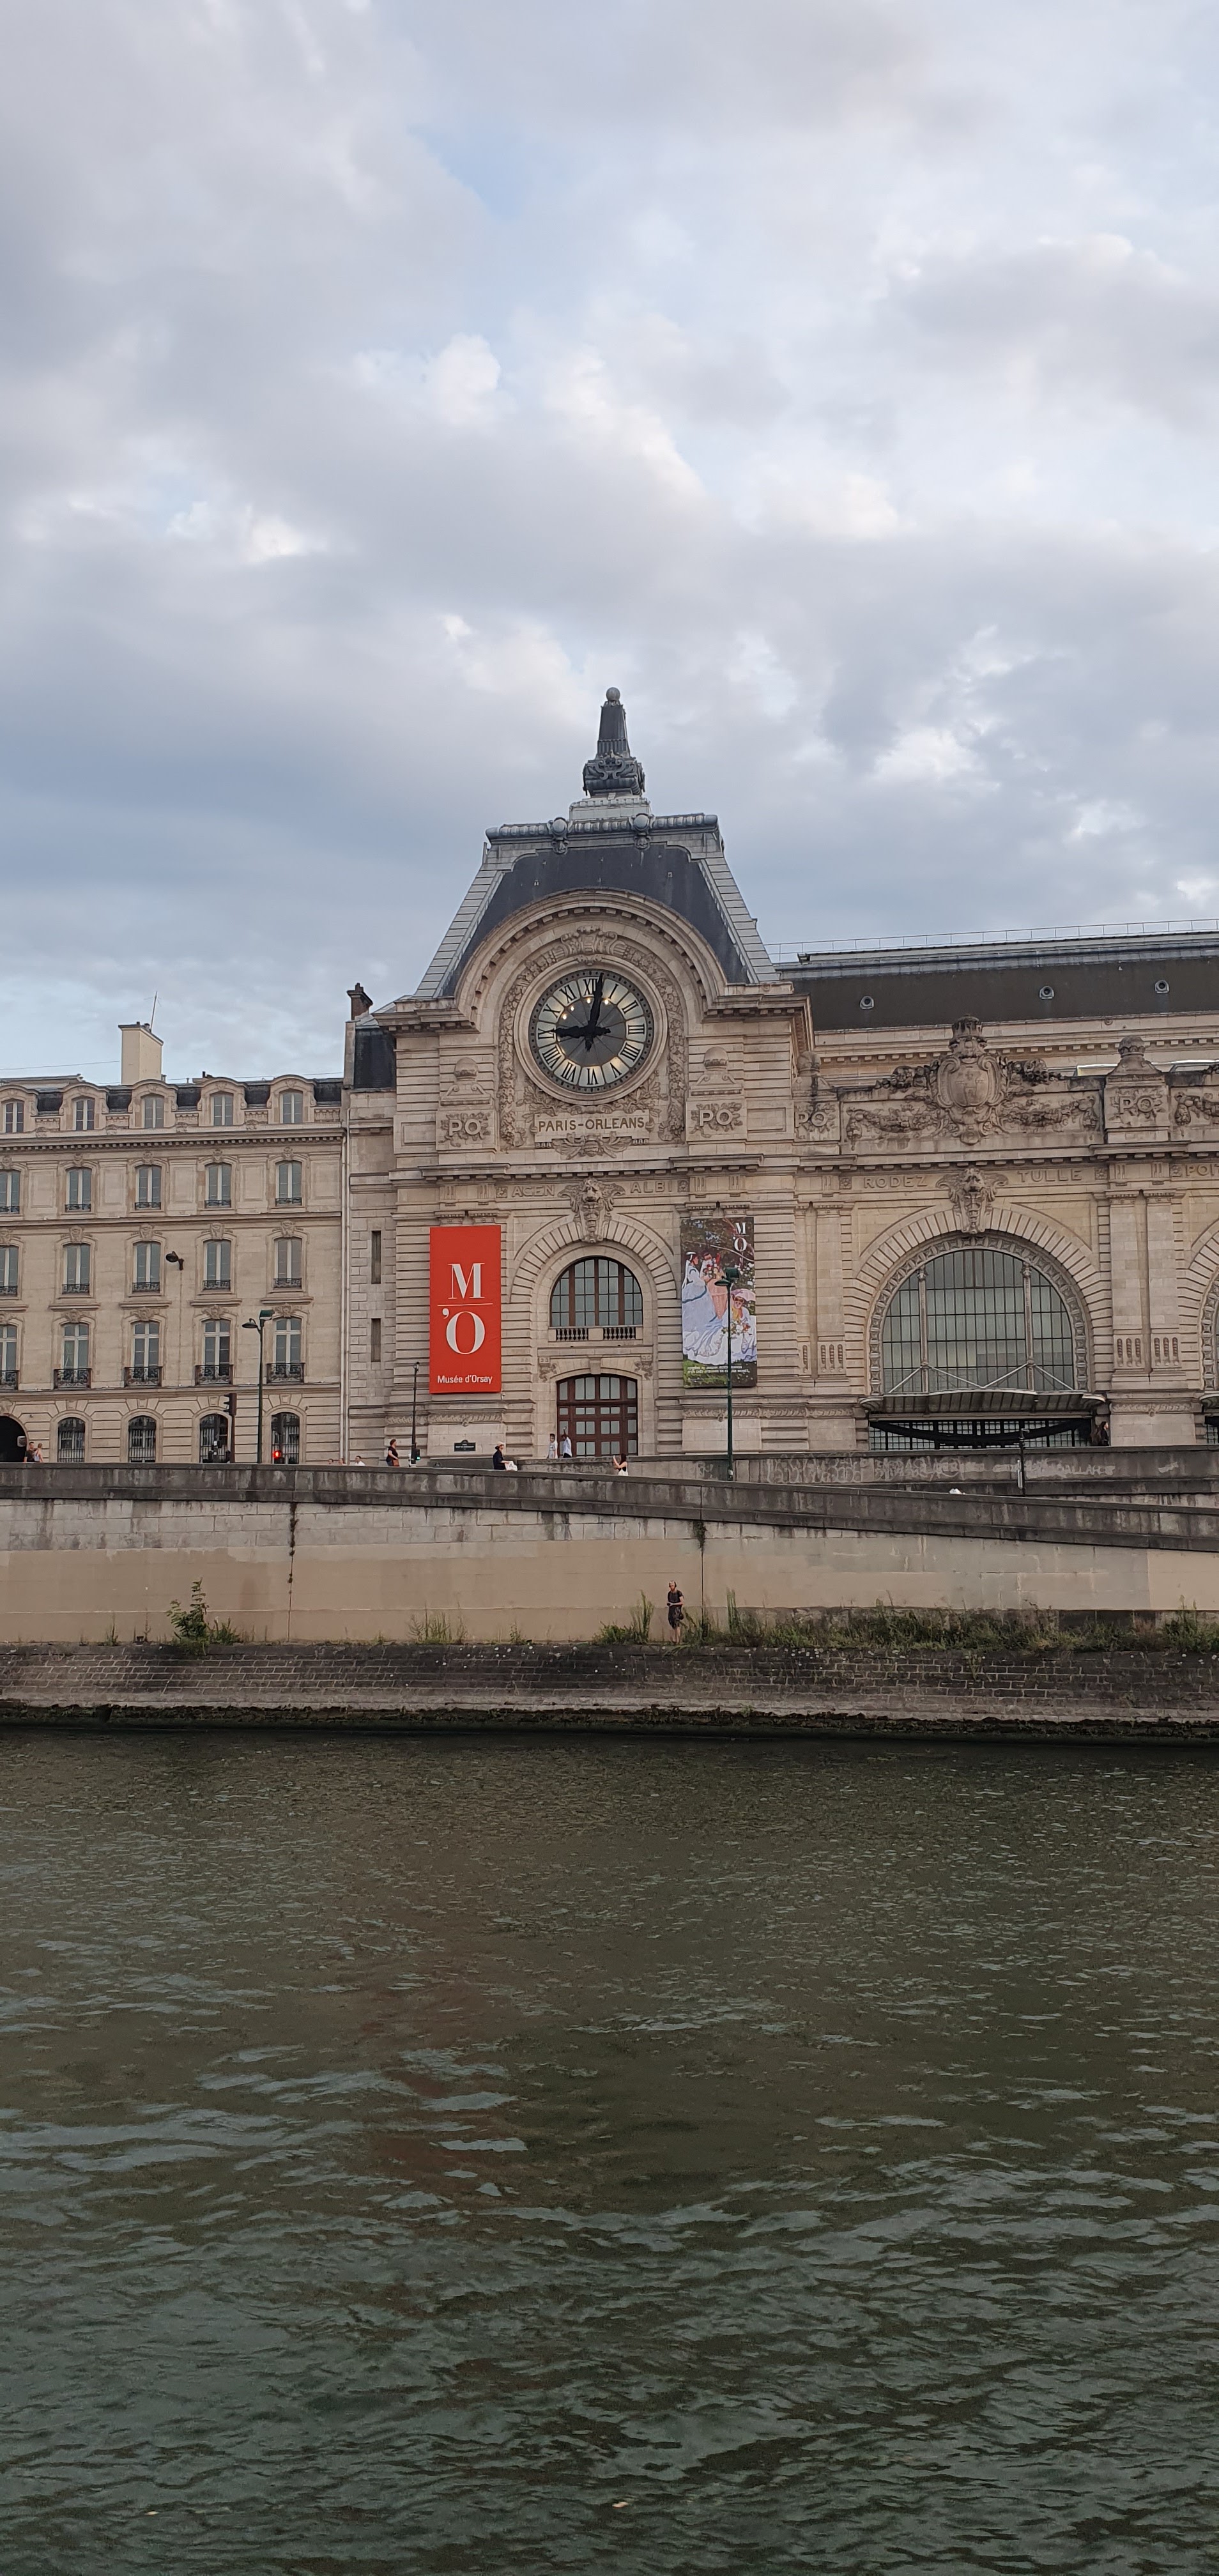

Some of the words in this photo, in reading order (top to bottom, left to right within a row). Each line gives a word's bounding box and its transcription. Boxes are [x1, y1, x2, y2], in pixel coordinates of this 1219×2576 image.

[559, 984, 577, 1004] XI
[608, 984, 619, 999] I
[543, 1004, 561, 1018] X
[622, 1000, 639, 1015] II
[537, 1027, 555, 1040] IX
[627, 1023, 645, 1035] III
[542, 1045, 562, 1069] VIII
[620, 1042, 641, 1062] IIII
[560, 1061, 576, 1083] VII
[586, 1068, 599, 1085] VI
[610, 1062, 622, 1078] V
[1120, 1096, 1153, 1114] PO
[539, 1117, 645, 1132] PARIS-ORLEANS
[699, 1109, 733, 1126] PO
[794, 1112, 827, 1128] PO
[449, 1119, 481, 1136] PO
[864, 1176, 928, 1188] RODEZ
[1017, 1169, 1082, 1183] TULLE
[630, 1180, 673, 1193] ALBI
[735, 1222, 746, 1234] M
[448, 1262, 485, 1299] M
[437, 1374, 463, 1384] Musée
[464, 1374, 493, 1384] d'Orsay
